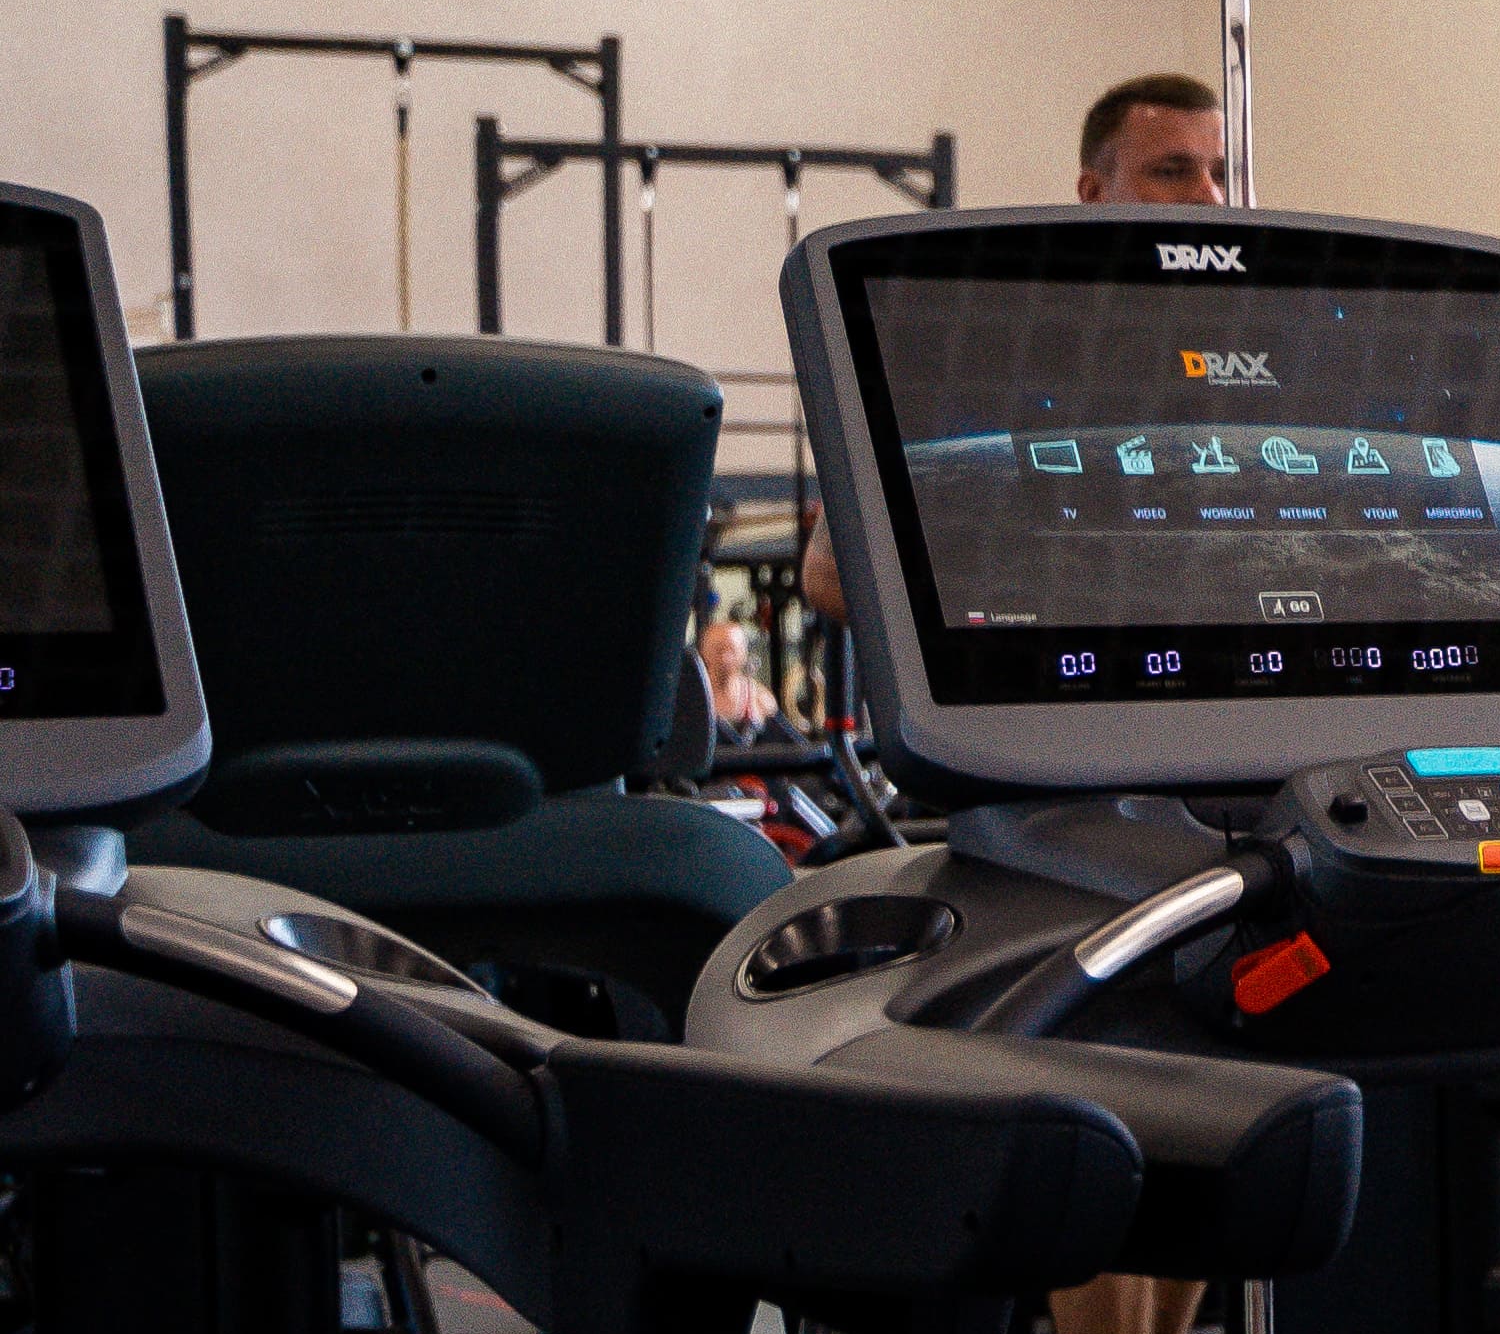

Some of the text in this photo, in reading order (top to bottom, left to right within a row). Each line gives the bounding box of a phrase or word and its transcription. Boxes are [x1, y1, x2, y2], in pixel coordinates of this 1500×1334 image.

[1156, 243, 1247, 272] DRAX
[1179, 349, 1274, 379] DRAX
[1062, 507, 1078, 520] TV
[1132, 507, 1167, 520] VIDEO
